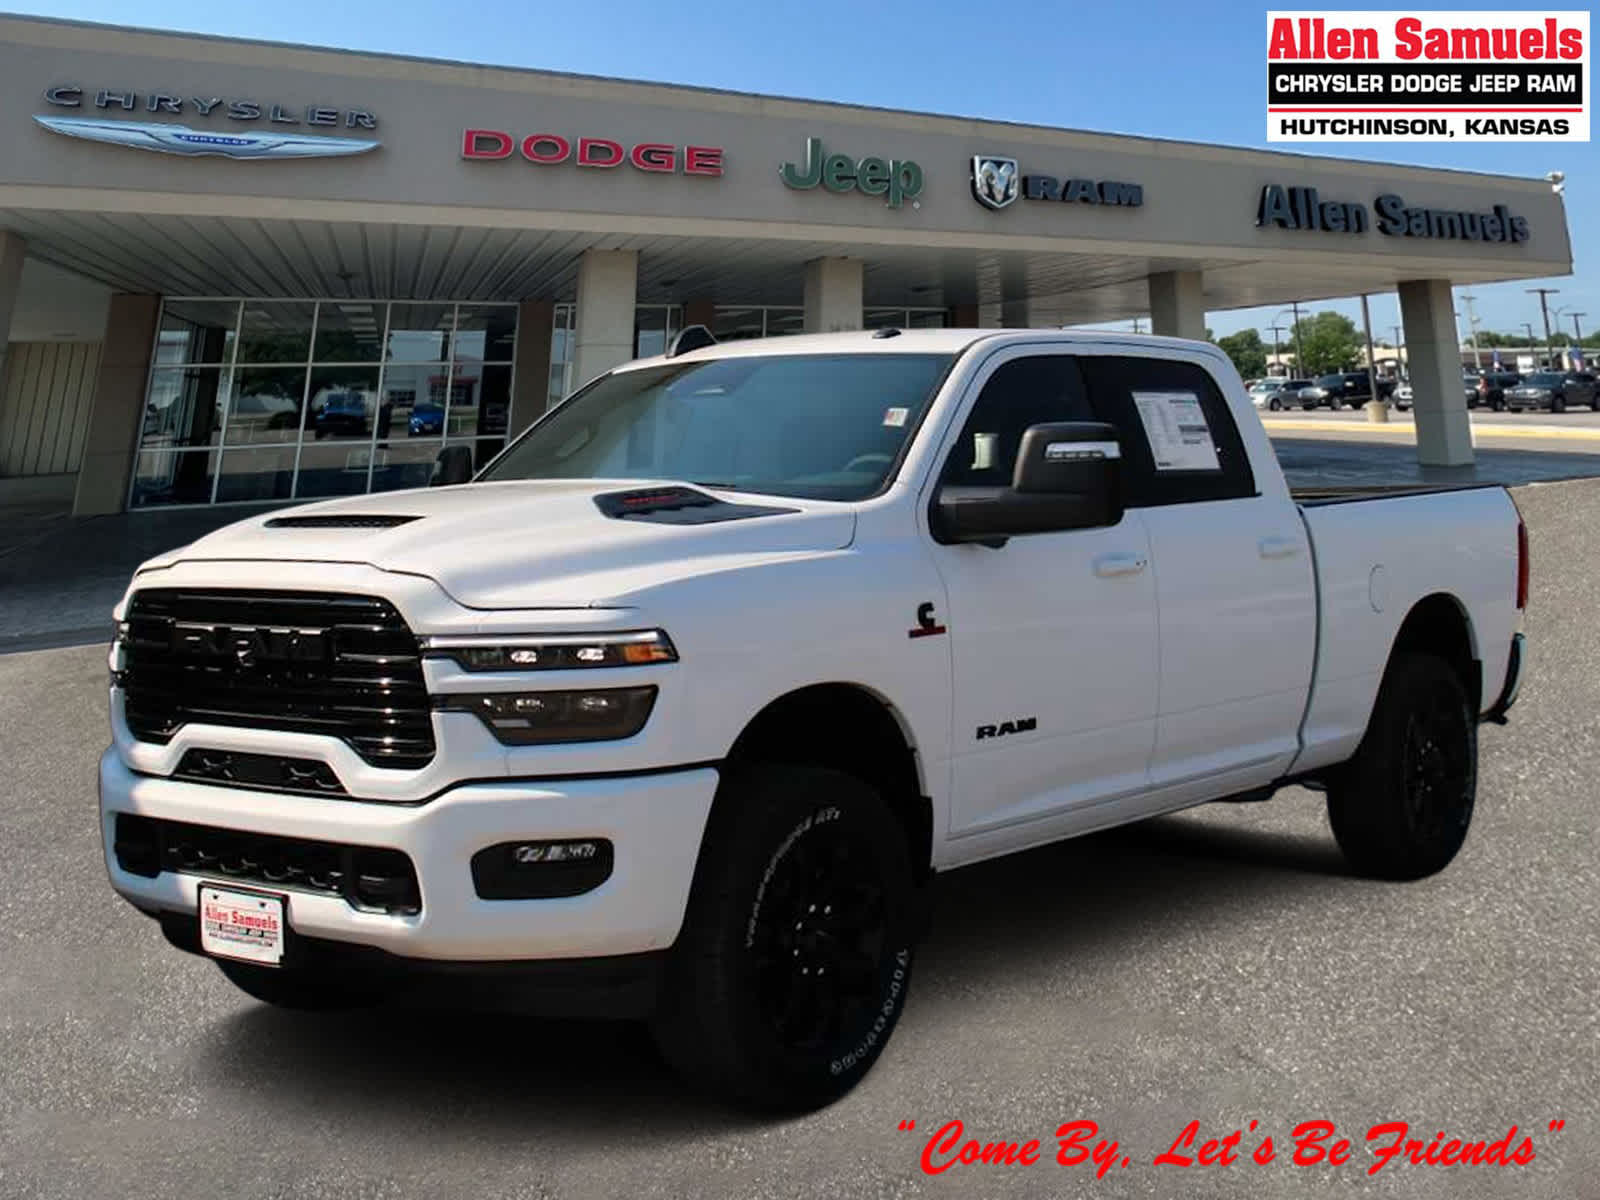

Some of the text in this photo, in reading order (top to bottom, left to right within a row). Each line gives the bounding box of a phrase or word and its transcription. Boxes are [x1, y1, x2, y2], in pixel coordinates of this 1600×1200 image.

[45, 86, 377, 129] CHRYSLER
[461, 128, 724, 177] DODGE
[779, 137, 923, 208] Jeep
[1022, 175, 1144, 207] RAM
[1256, 184, 1530, 243] Allen Samuels
[976, 717, 1037, 740] RAM
[232, 911, 278, 930] Samuels
